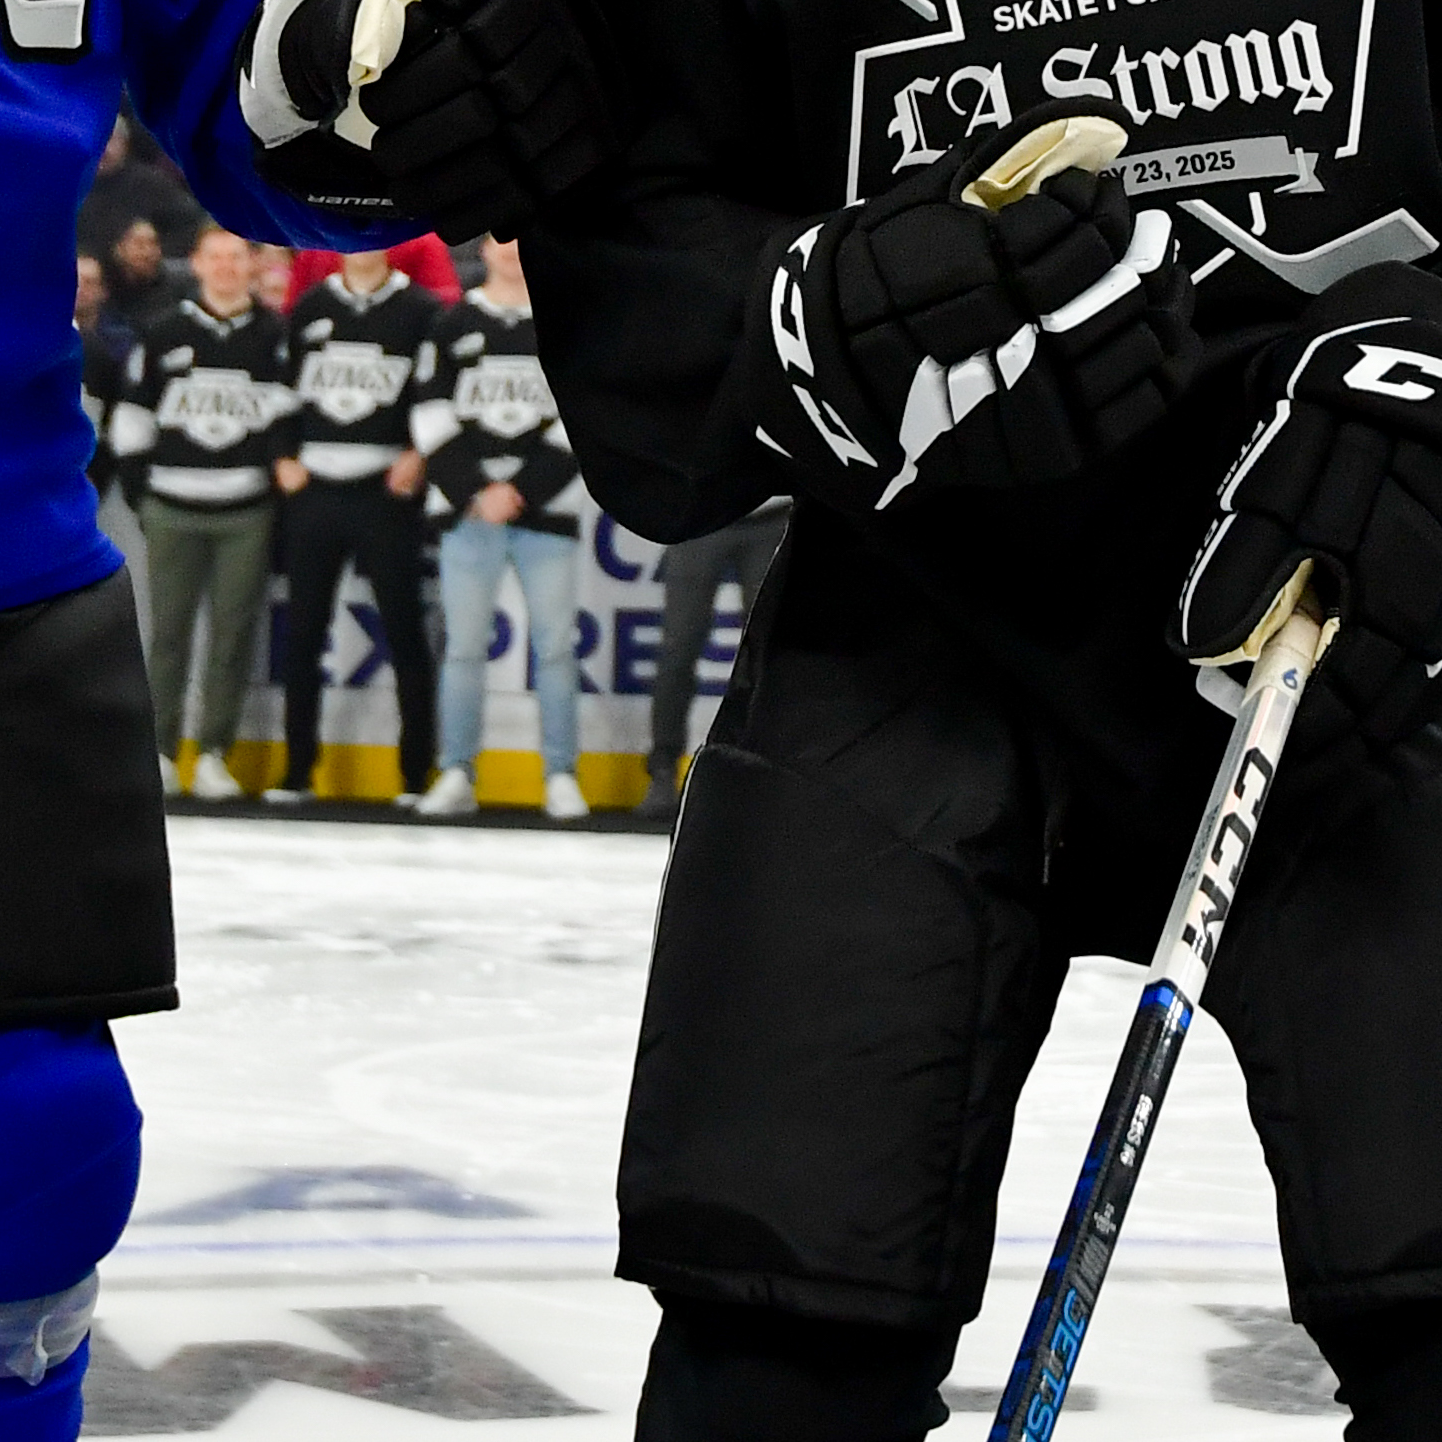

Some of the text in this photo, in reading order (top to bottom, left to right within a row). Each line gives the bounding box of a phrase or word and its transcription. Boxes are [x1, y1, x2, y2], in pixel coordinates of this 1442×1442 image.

[888, 18, 1334, 175] LA Strong
[1134, 159, 1172, 185] 23,
[1175, 150, 1237, 178] 2025
[1181, 747, 1274, 968] CCM
